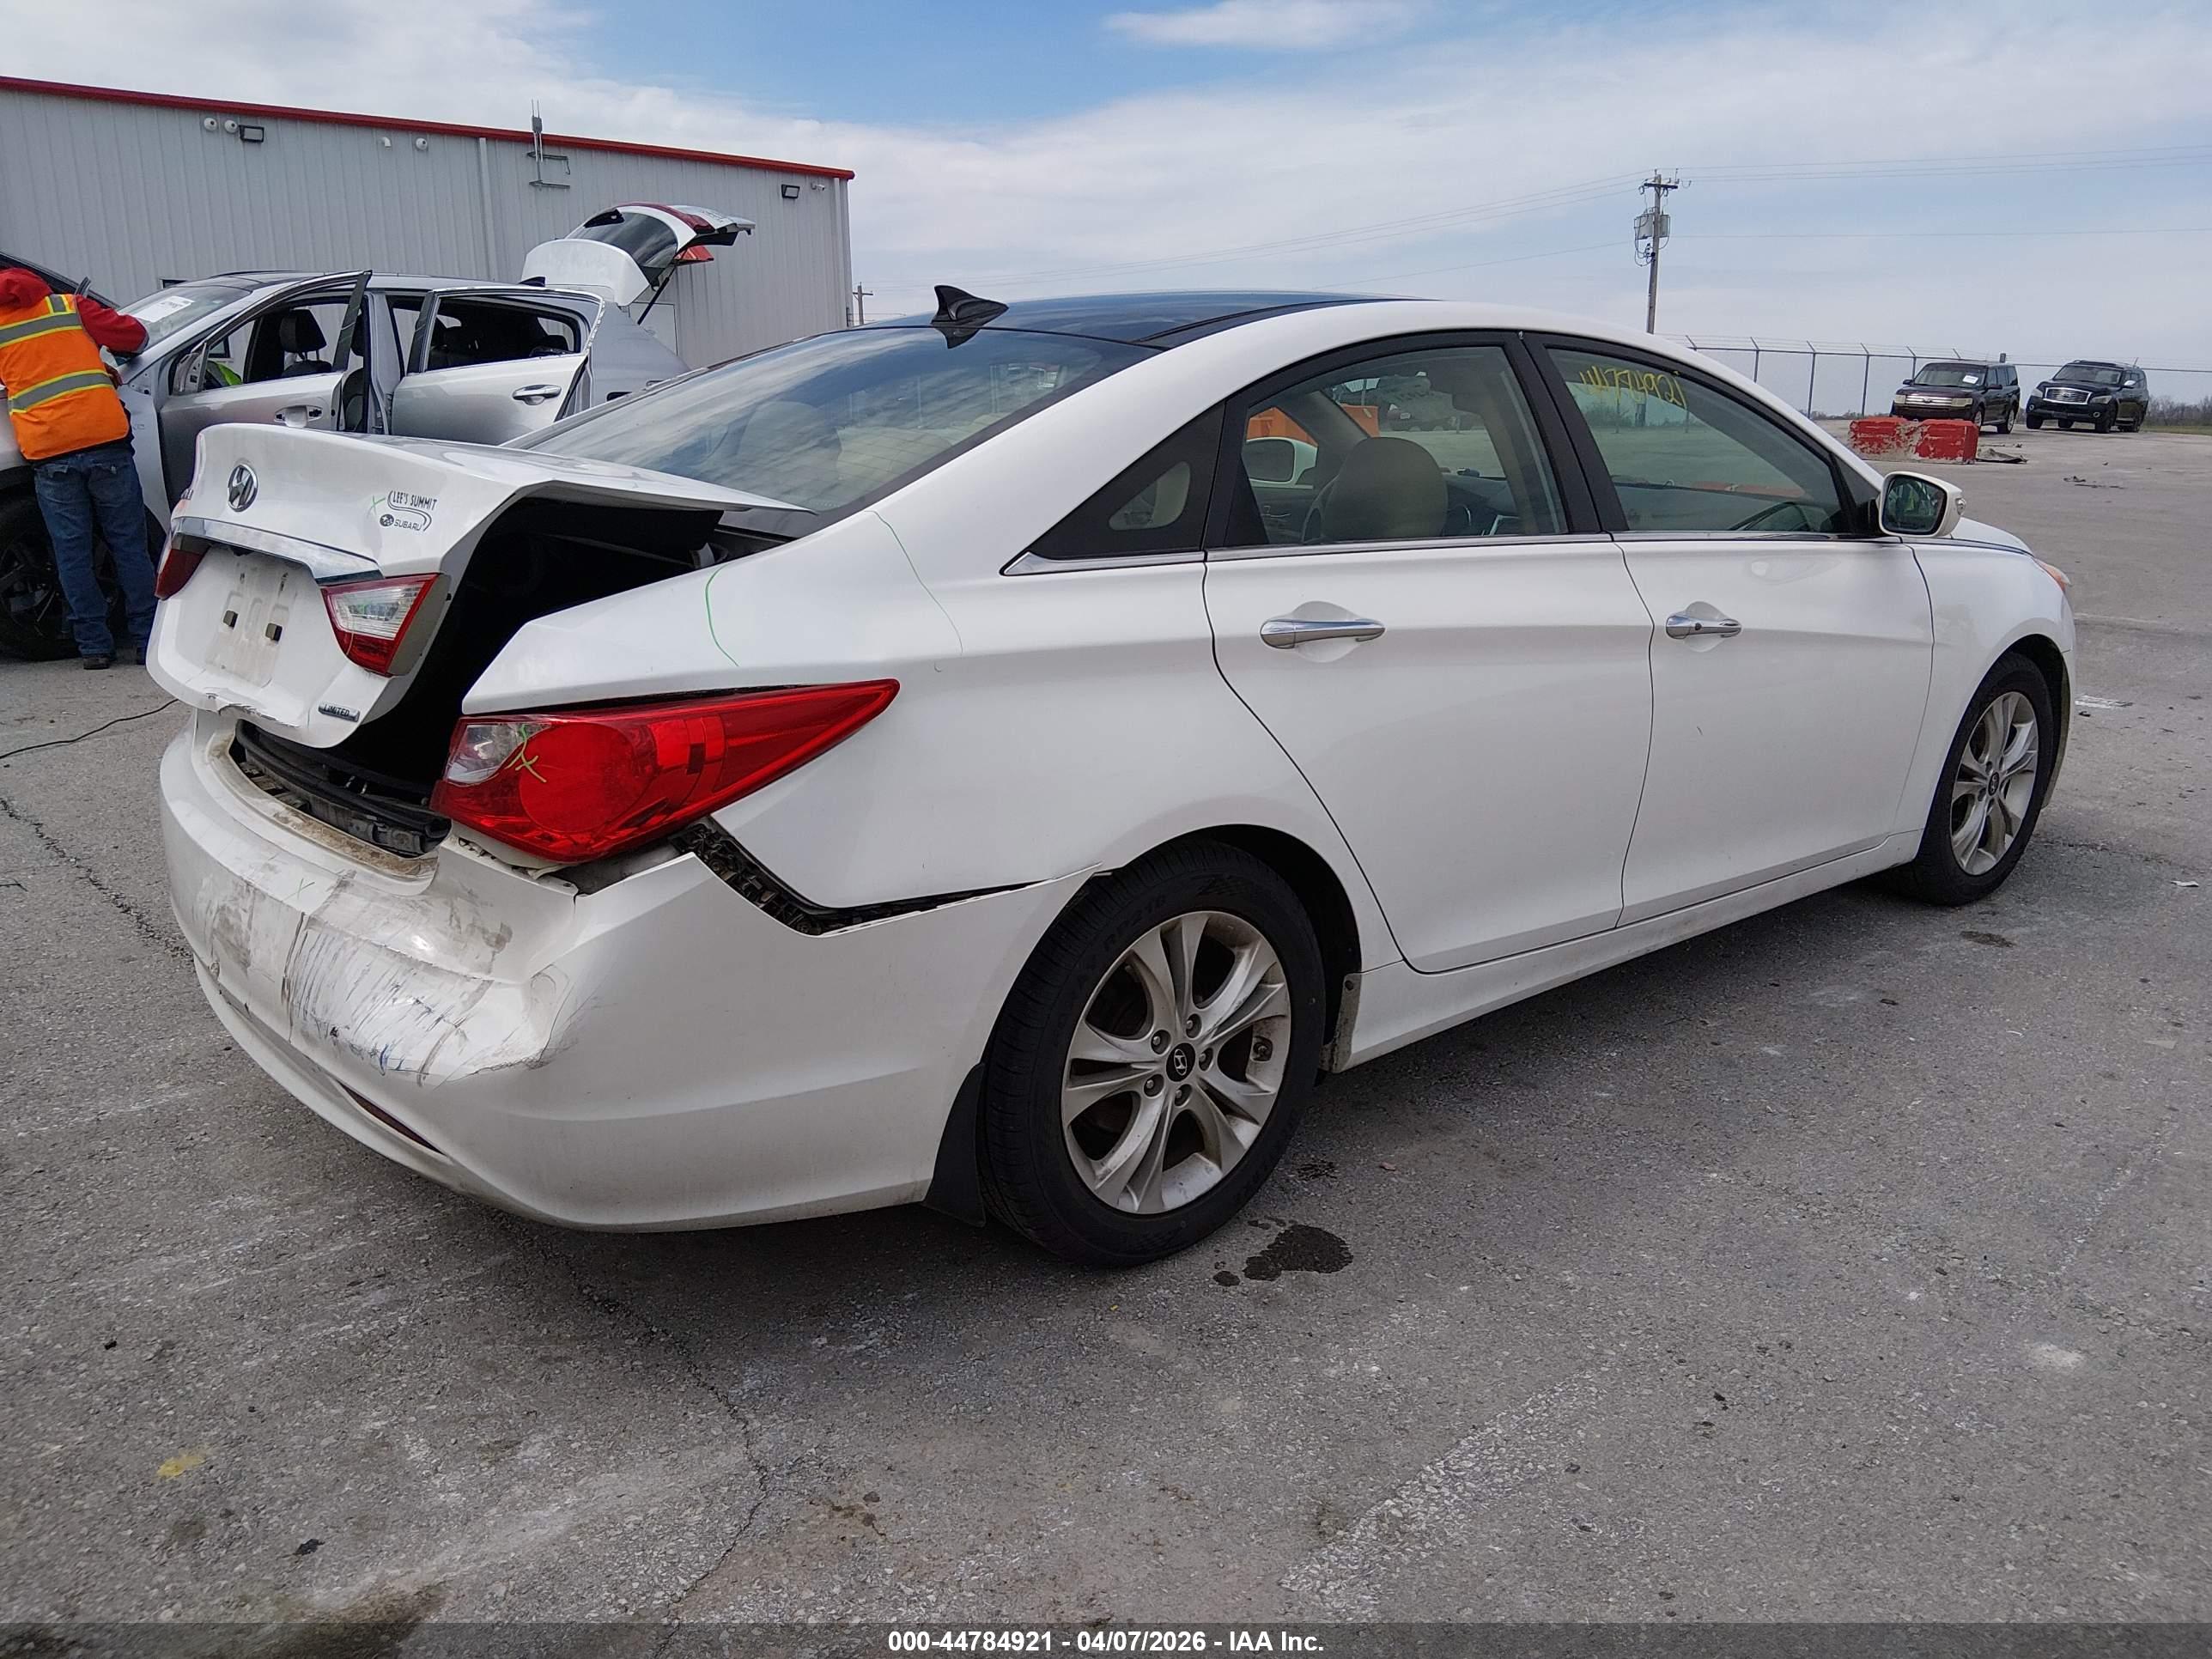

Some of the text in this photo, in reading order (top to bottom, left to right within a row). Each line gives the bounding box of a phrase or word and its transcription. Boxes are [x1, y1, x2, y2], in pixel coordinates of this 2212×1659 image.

[392, 491, 437, 511] LEE'S SUMMIT
[393, 519, 422, 531] SUBARU
[323, 703, 350, 717] LIMITED
